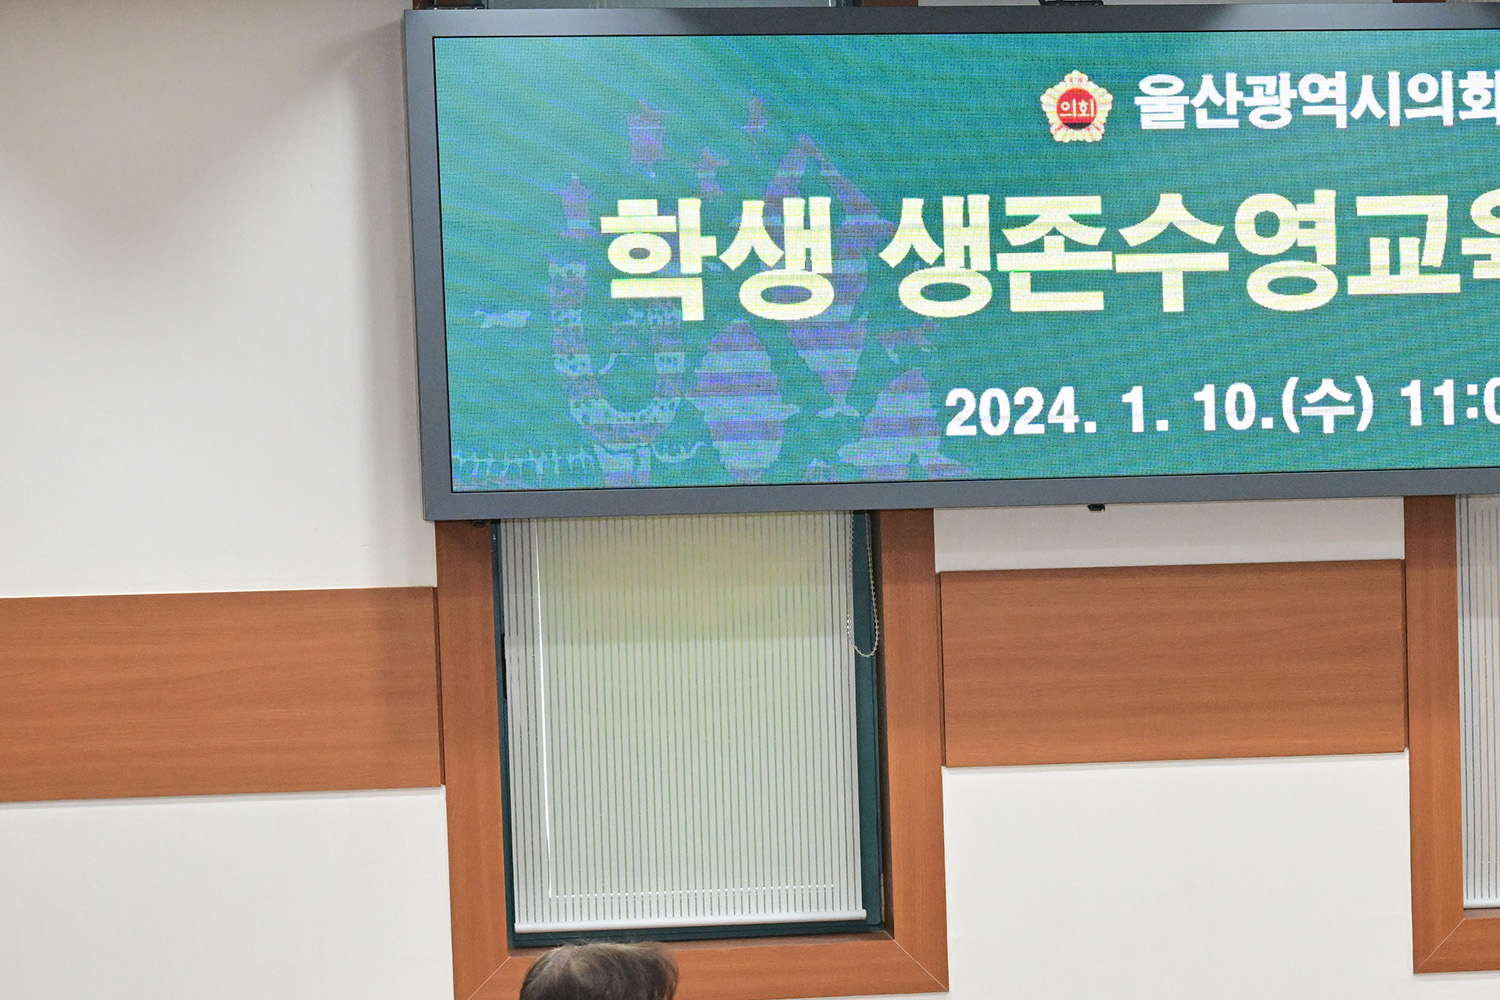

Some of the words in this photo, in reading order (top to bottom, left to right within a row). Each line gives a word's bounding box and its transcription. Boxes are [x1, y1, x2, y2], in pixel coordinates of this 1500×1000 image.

[1060, 98, 1095, 118] 의회
[600, 196, 835, 321] 학생
[945, 386, 1097, 436] 2024.
[1121, 385, 1169, 433] 1.
[1193, 375, 1374, 434] 10.(수)
